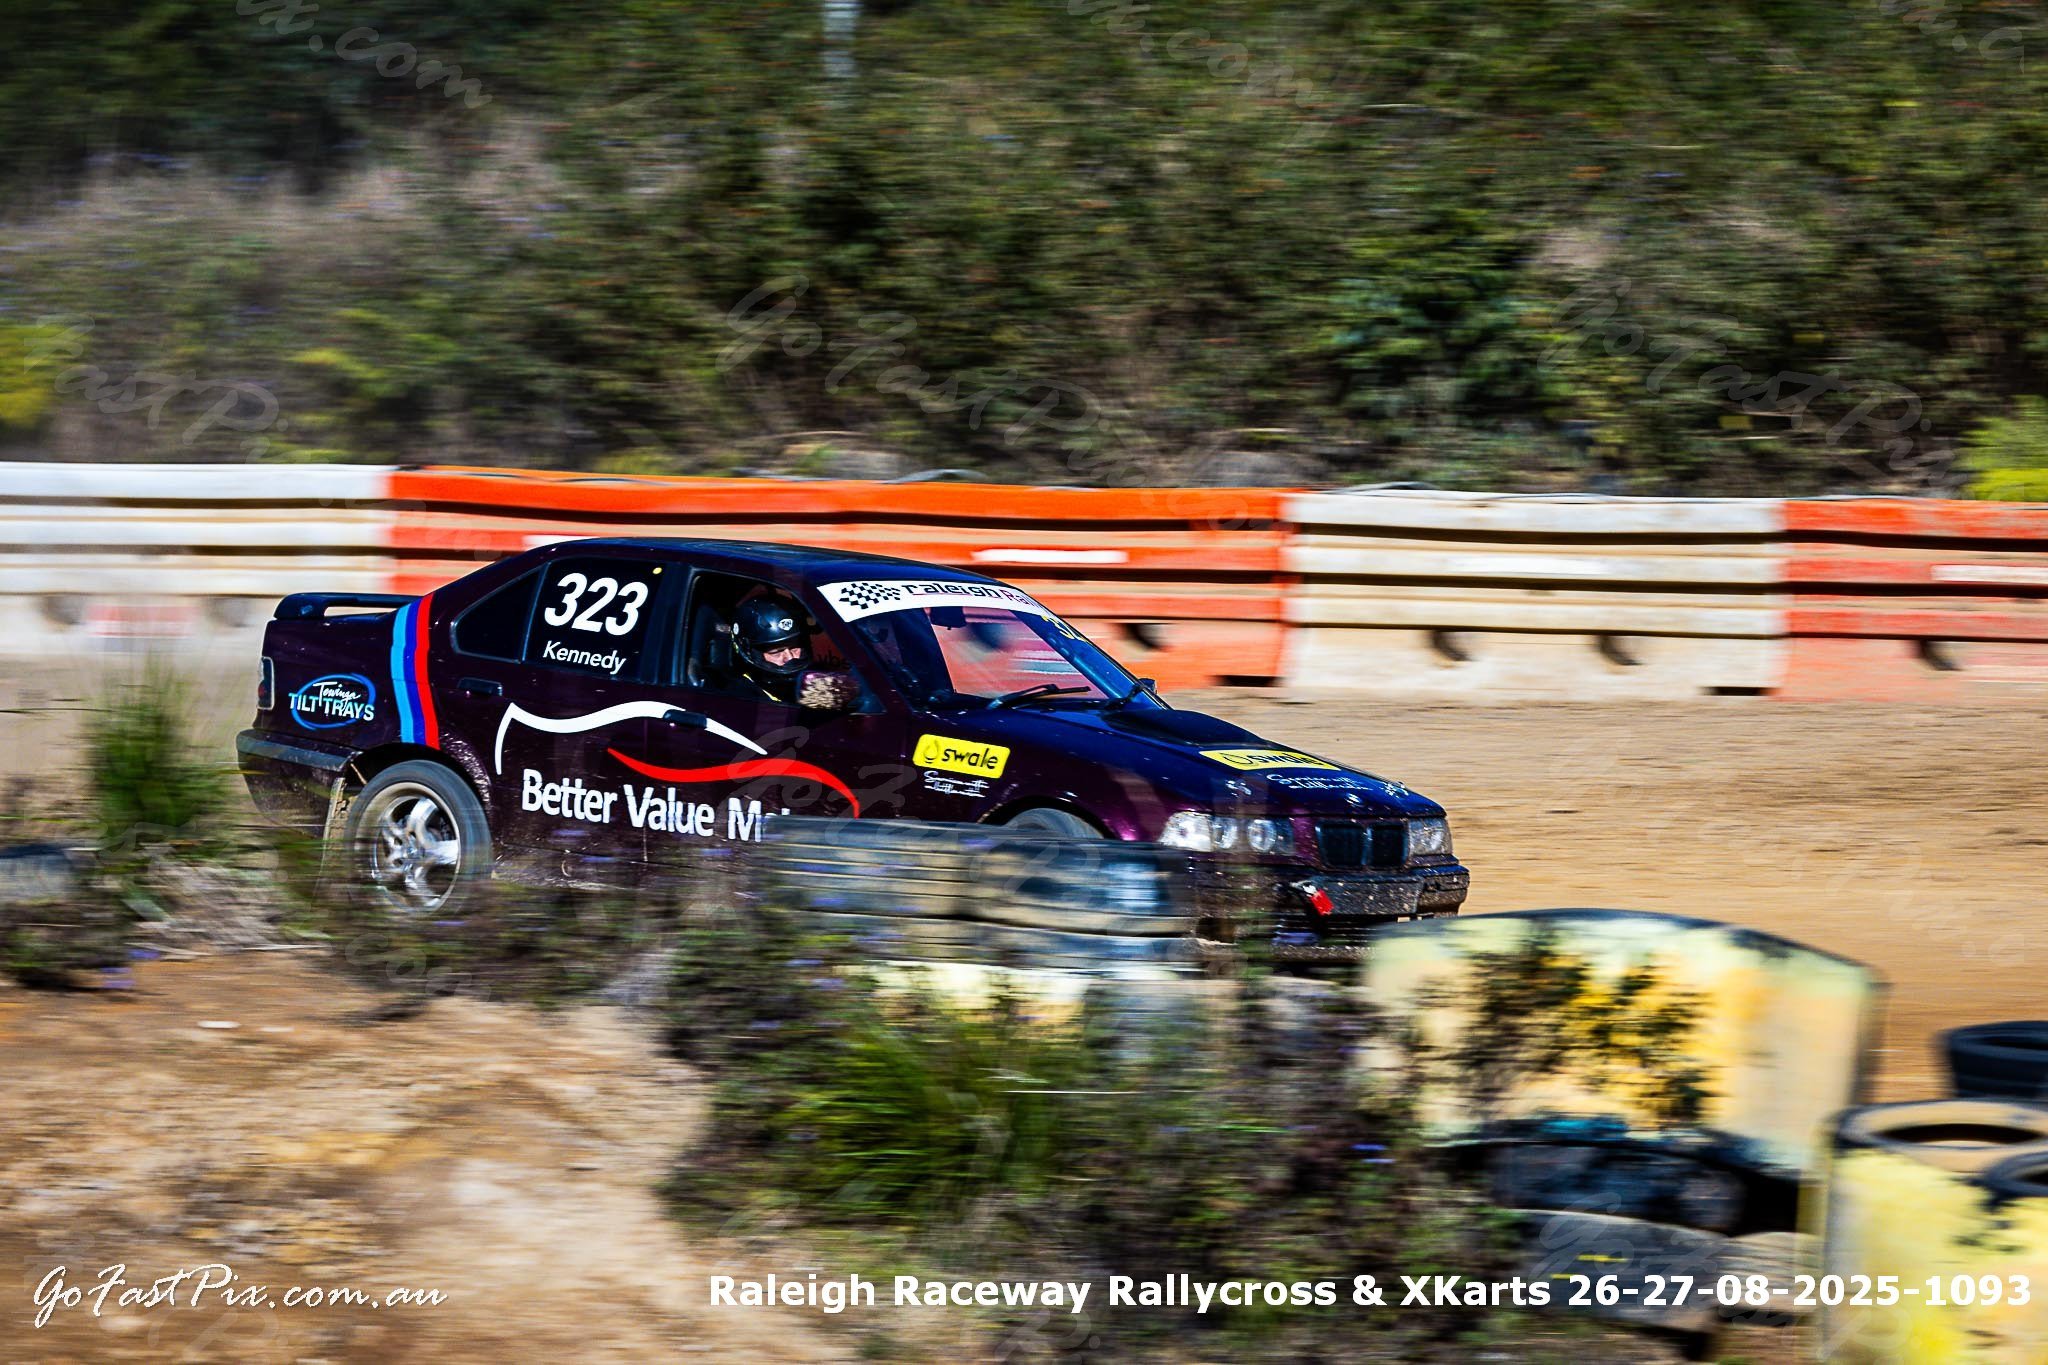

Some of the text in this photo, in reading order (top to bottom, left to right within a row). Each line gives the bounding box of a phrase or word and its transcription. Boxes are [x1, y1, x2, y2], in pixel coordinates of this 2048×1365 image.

[544, 572, 649, 636] 323
[901, 582, 1000, 599] raleigh
[542, 640, 627, 676] Kennedy
[288, 692, 376, 721] TILT TRAYS
[941, 748, 998, 769] swale
[521, 768, 618, 824] Better
[623, 784, 715, 837] Value
